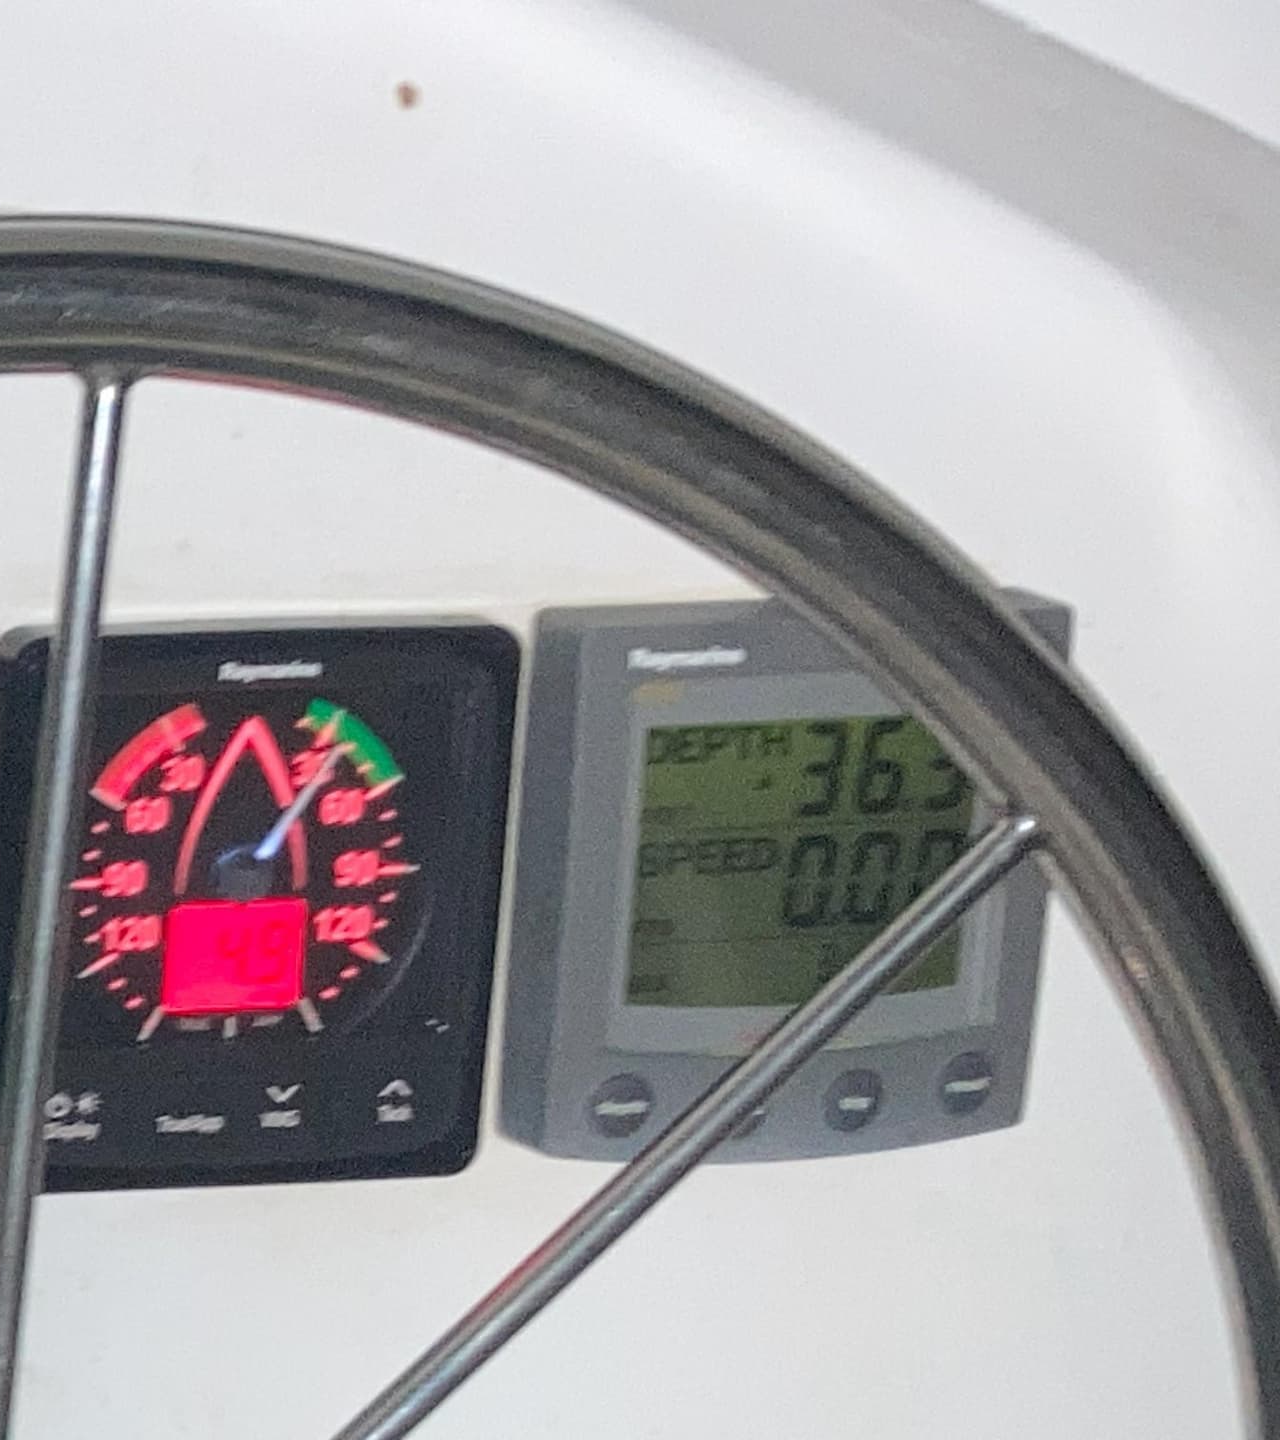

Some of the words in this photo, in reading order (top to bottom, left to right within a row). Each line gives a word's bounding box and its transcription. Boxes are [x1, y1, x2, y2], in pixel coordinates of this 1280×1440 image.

[647, 726, 794, 766] DEPTH
[638, 836, 782, 878] SPEED
[217, 918, 289, 985] 49
